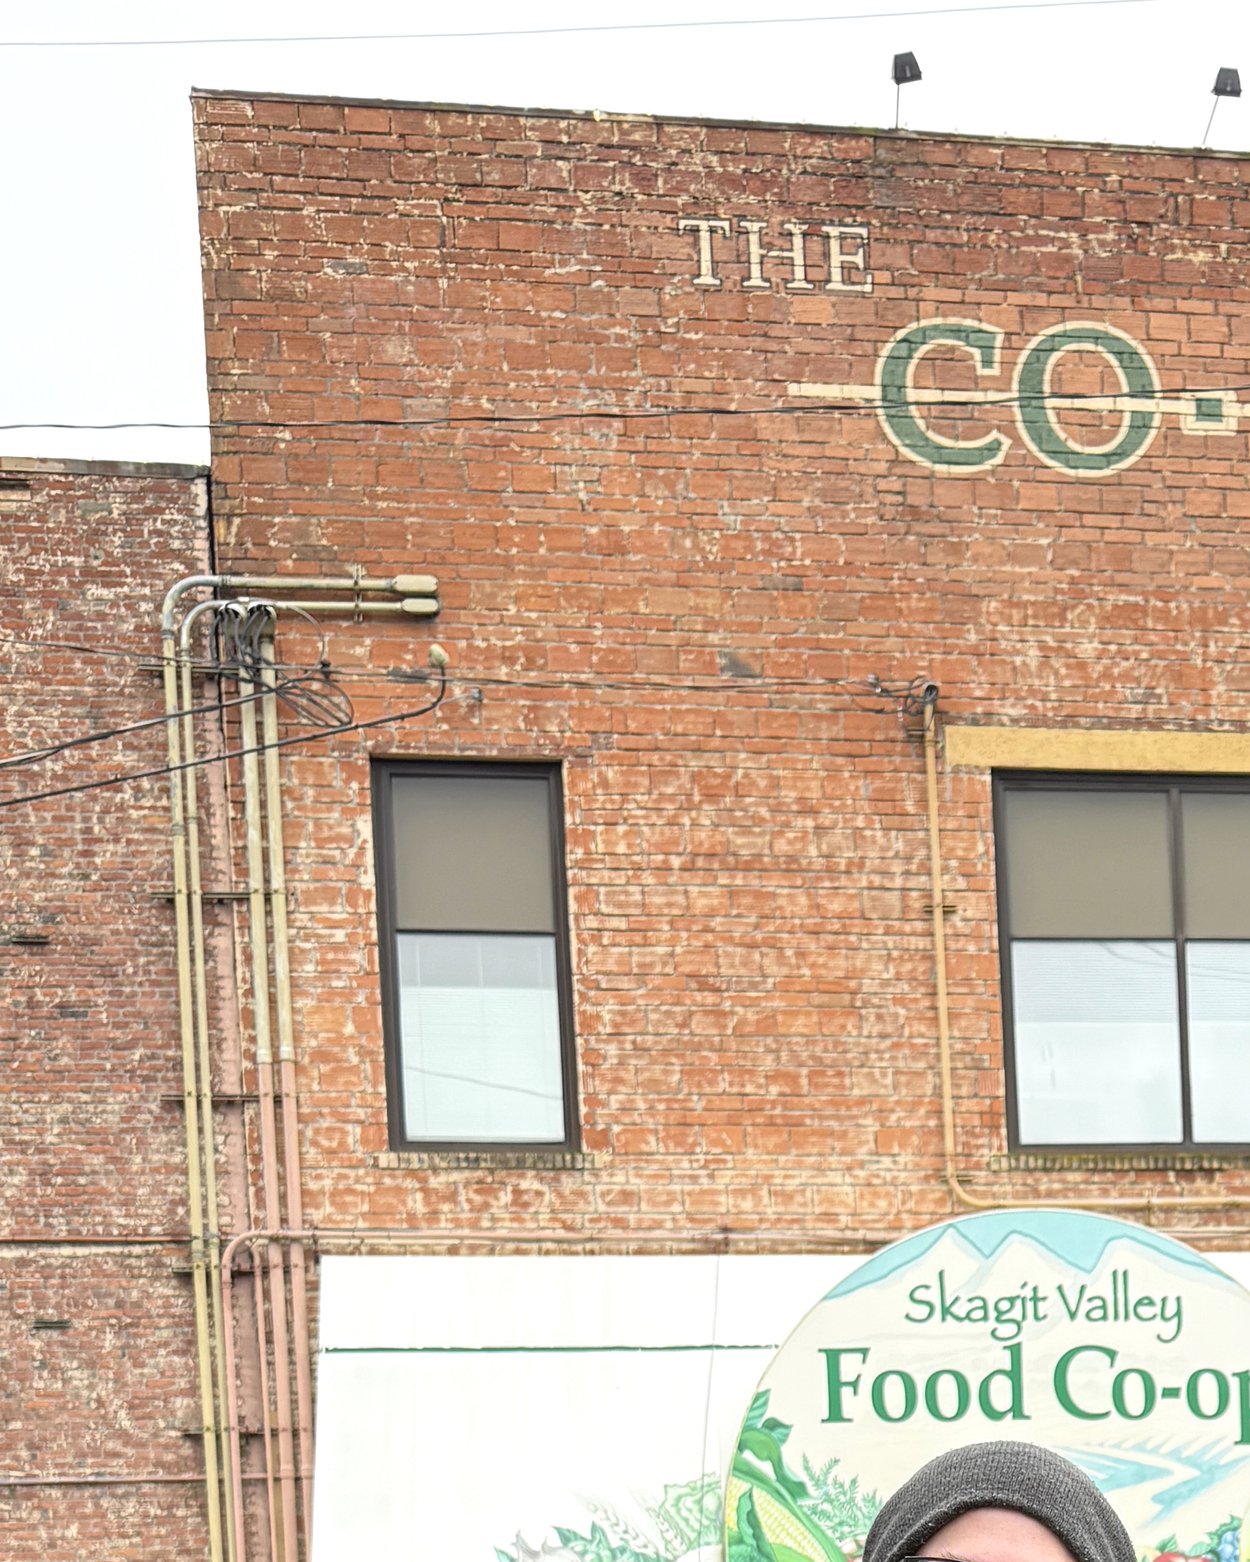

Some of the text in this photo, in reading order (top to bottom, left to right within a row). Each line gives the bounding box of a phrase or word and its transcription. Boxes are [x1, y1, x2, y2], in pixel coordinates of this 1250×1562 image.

[679, 217, 875, 294] THE
[905, 1269, 1183, 1343] Skagit Valley
[818, 1342, 1032, 1424] Food
